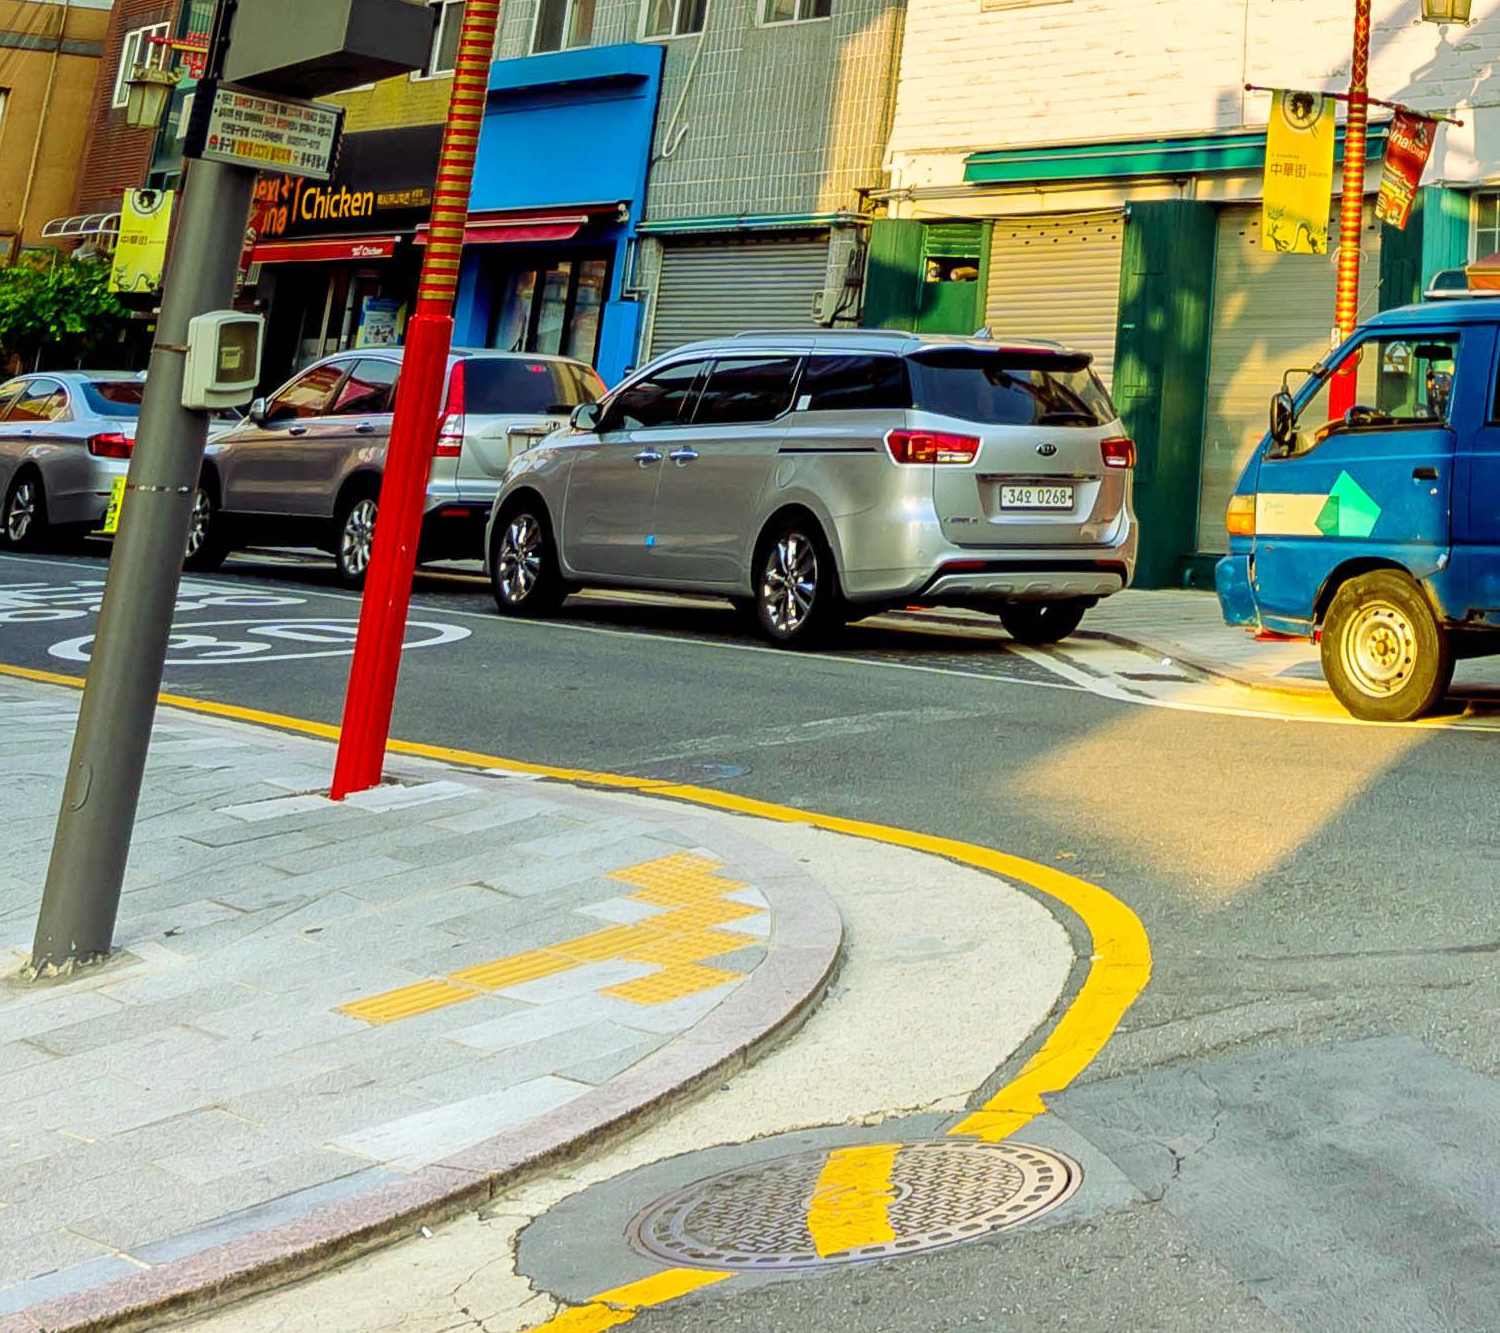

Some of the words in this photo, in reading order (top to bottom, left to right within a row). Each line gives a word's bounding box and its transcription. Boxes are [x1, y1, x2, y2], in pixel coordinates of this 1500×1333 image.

[1270, 161, 1307, 179] 中華街
[301, 186, 374, 220] Chicken
[1037, 489, 1067, 504] 0268
